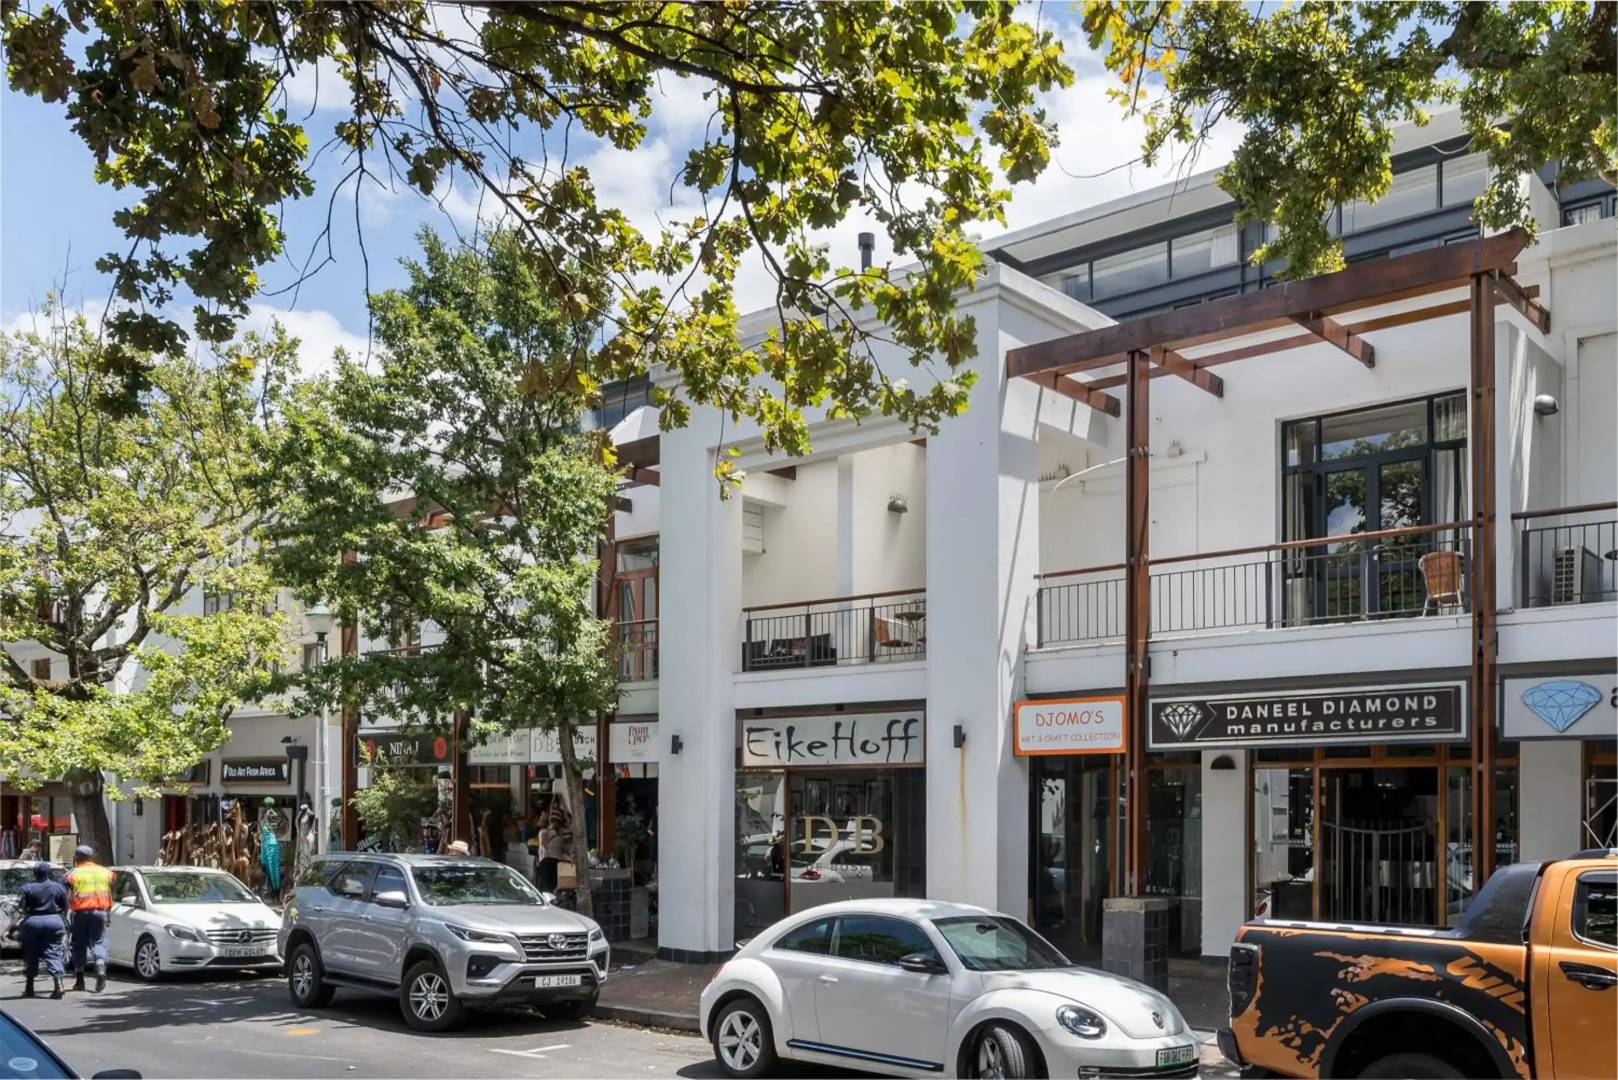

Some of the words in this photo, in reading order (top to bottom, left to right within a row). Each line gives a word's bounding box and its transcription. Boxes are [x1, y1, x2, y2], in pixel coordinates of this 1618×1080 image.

[1226, 702, 1312, 720] DANEEL
[1322, 695, 1437, 716] DIAMOND
[1035, 710, 1104, 727] DJOMO'S
[1226, 715, 1437, 735] manufacturers
[746, 718, 919, 763] EikeHoff
[1021, 735, 1037, 743] ART
[1044, 734, 1068, 742] CRAFT
[1070, 732, 1121, 742] COLLECTION
[259, 765, 276, 777] AFRICA
[542, 977, 551, 986] CJ
[557, 976, 576, 986] 19186
